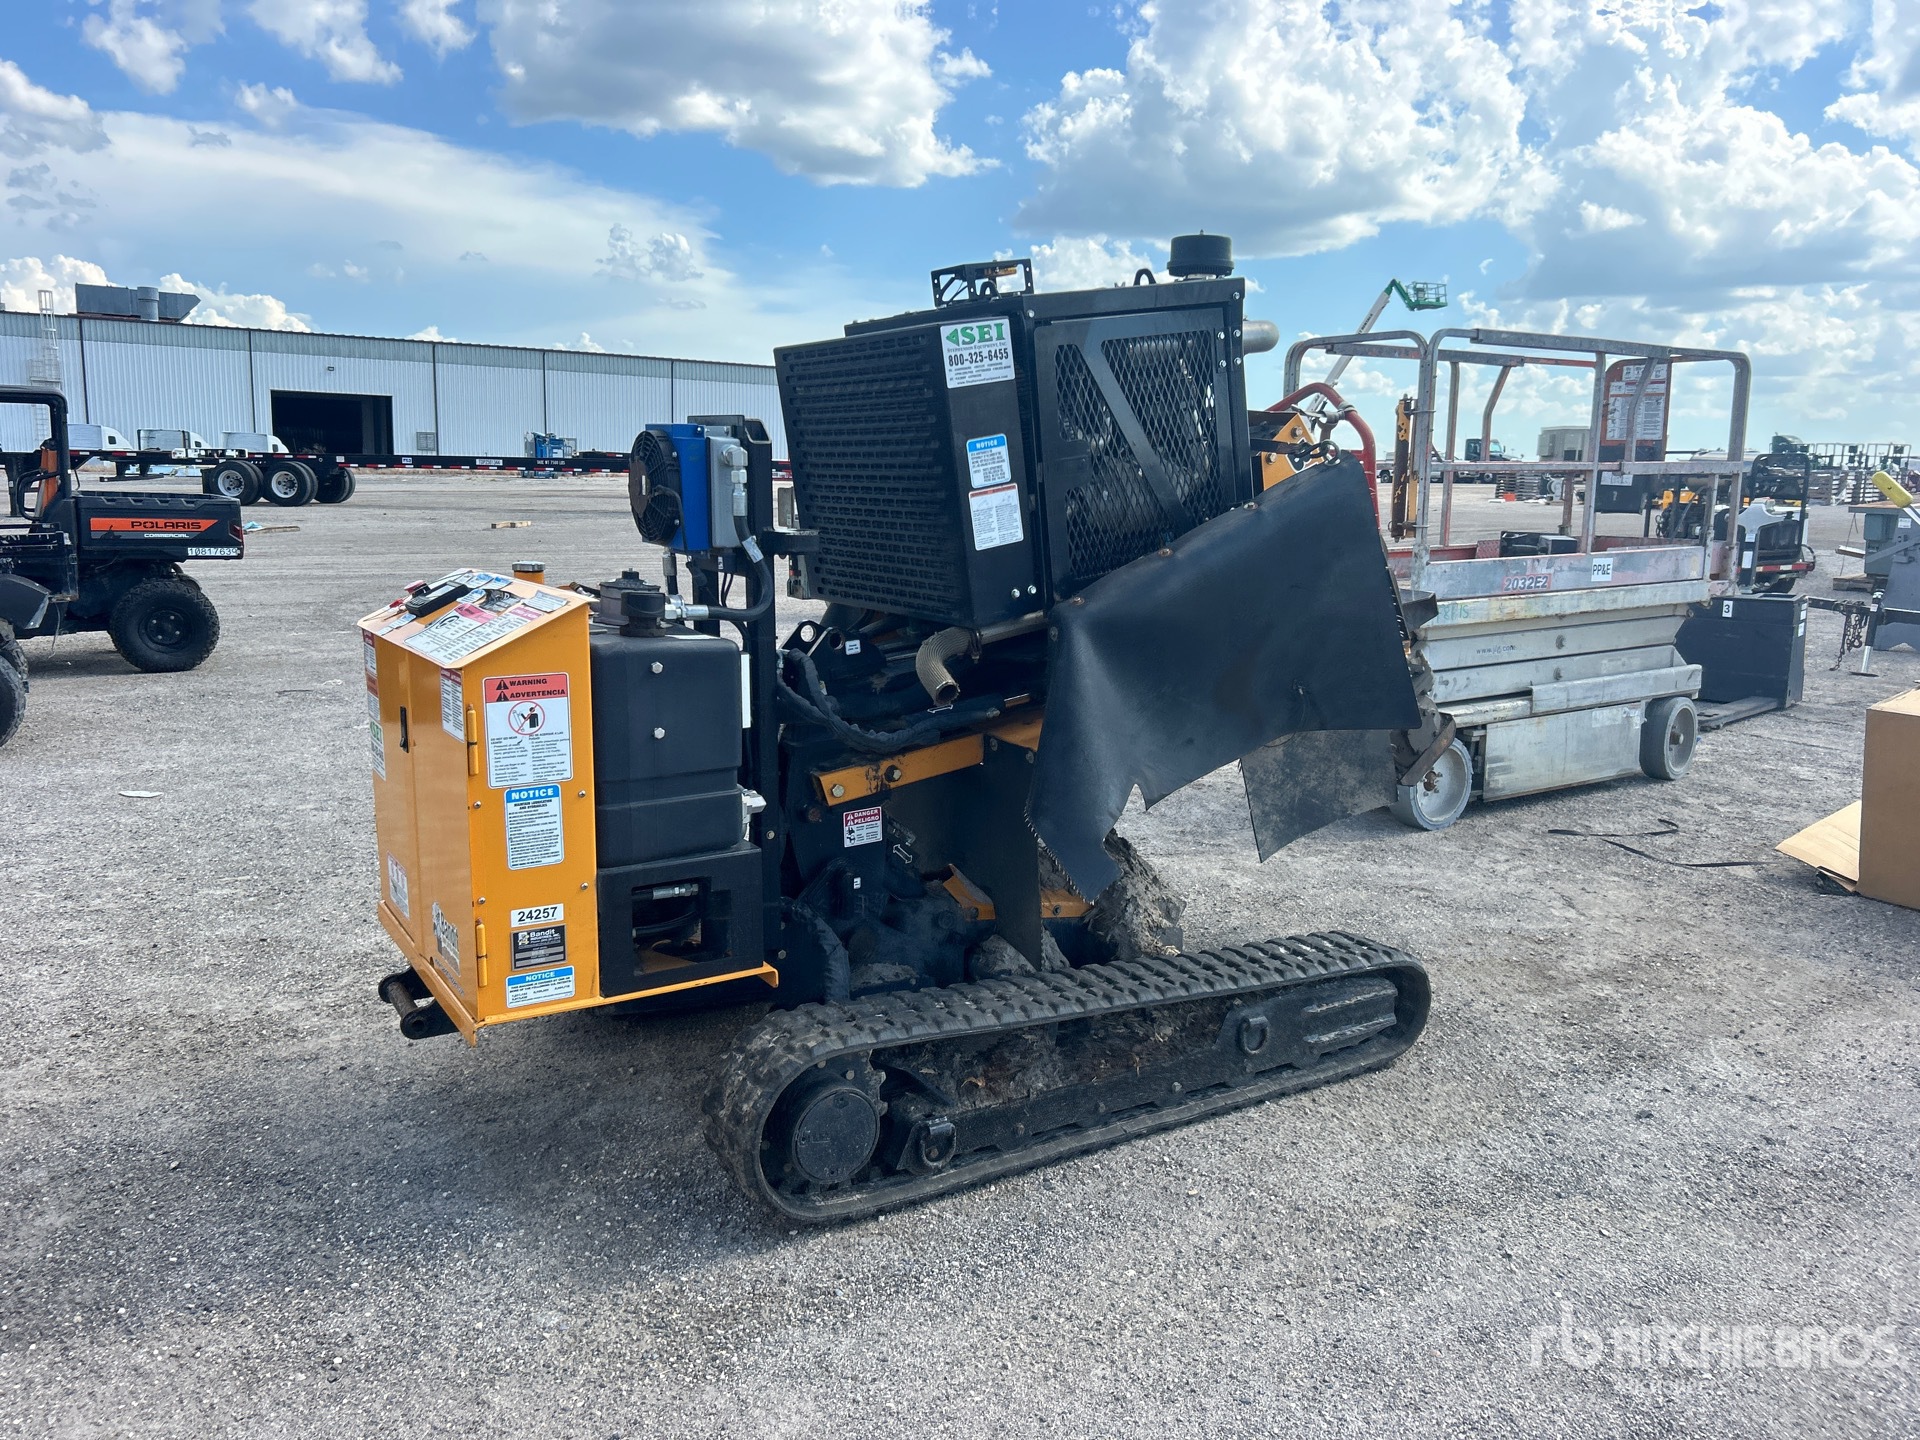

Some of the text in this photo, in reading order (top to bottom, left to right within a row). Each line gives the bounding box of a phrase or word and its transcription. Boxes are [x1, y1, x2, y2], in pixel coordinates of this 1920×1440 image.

[960, 322, 1006, 345] SEI
[948, 347, 1009, 367] 800-325-6455
[976, 439, 998, 449] NOTICE
[131, 521, 202, 530] POLARIS
[1592, 563, 1612, 576] PP&E
[1504, 575, 1549, 592] 2032E2
[1723, 604, 1731, 614] 3
[509, 678, 548, 687] WARNING
[510, 689, 566, 699] ADVERTENCIA
[511, 787, 554, 800] NOTICE
[854, 809, 879, 818] DANGER
[854, 815, 880, 824] PELIGRO
[517, 906, 558, 922] 24257
[530, 929, 556, 938] Bandit
[525, 971, 556, 982] NOTICE
